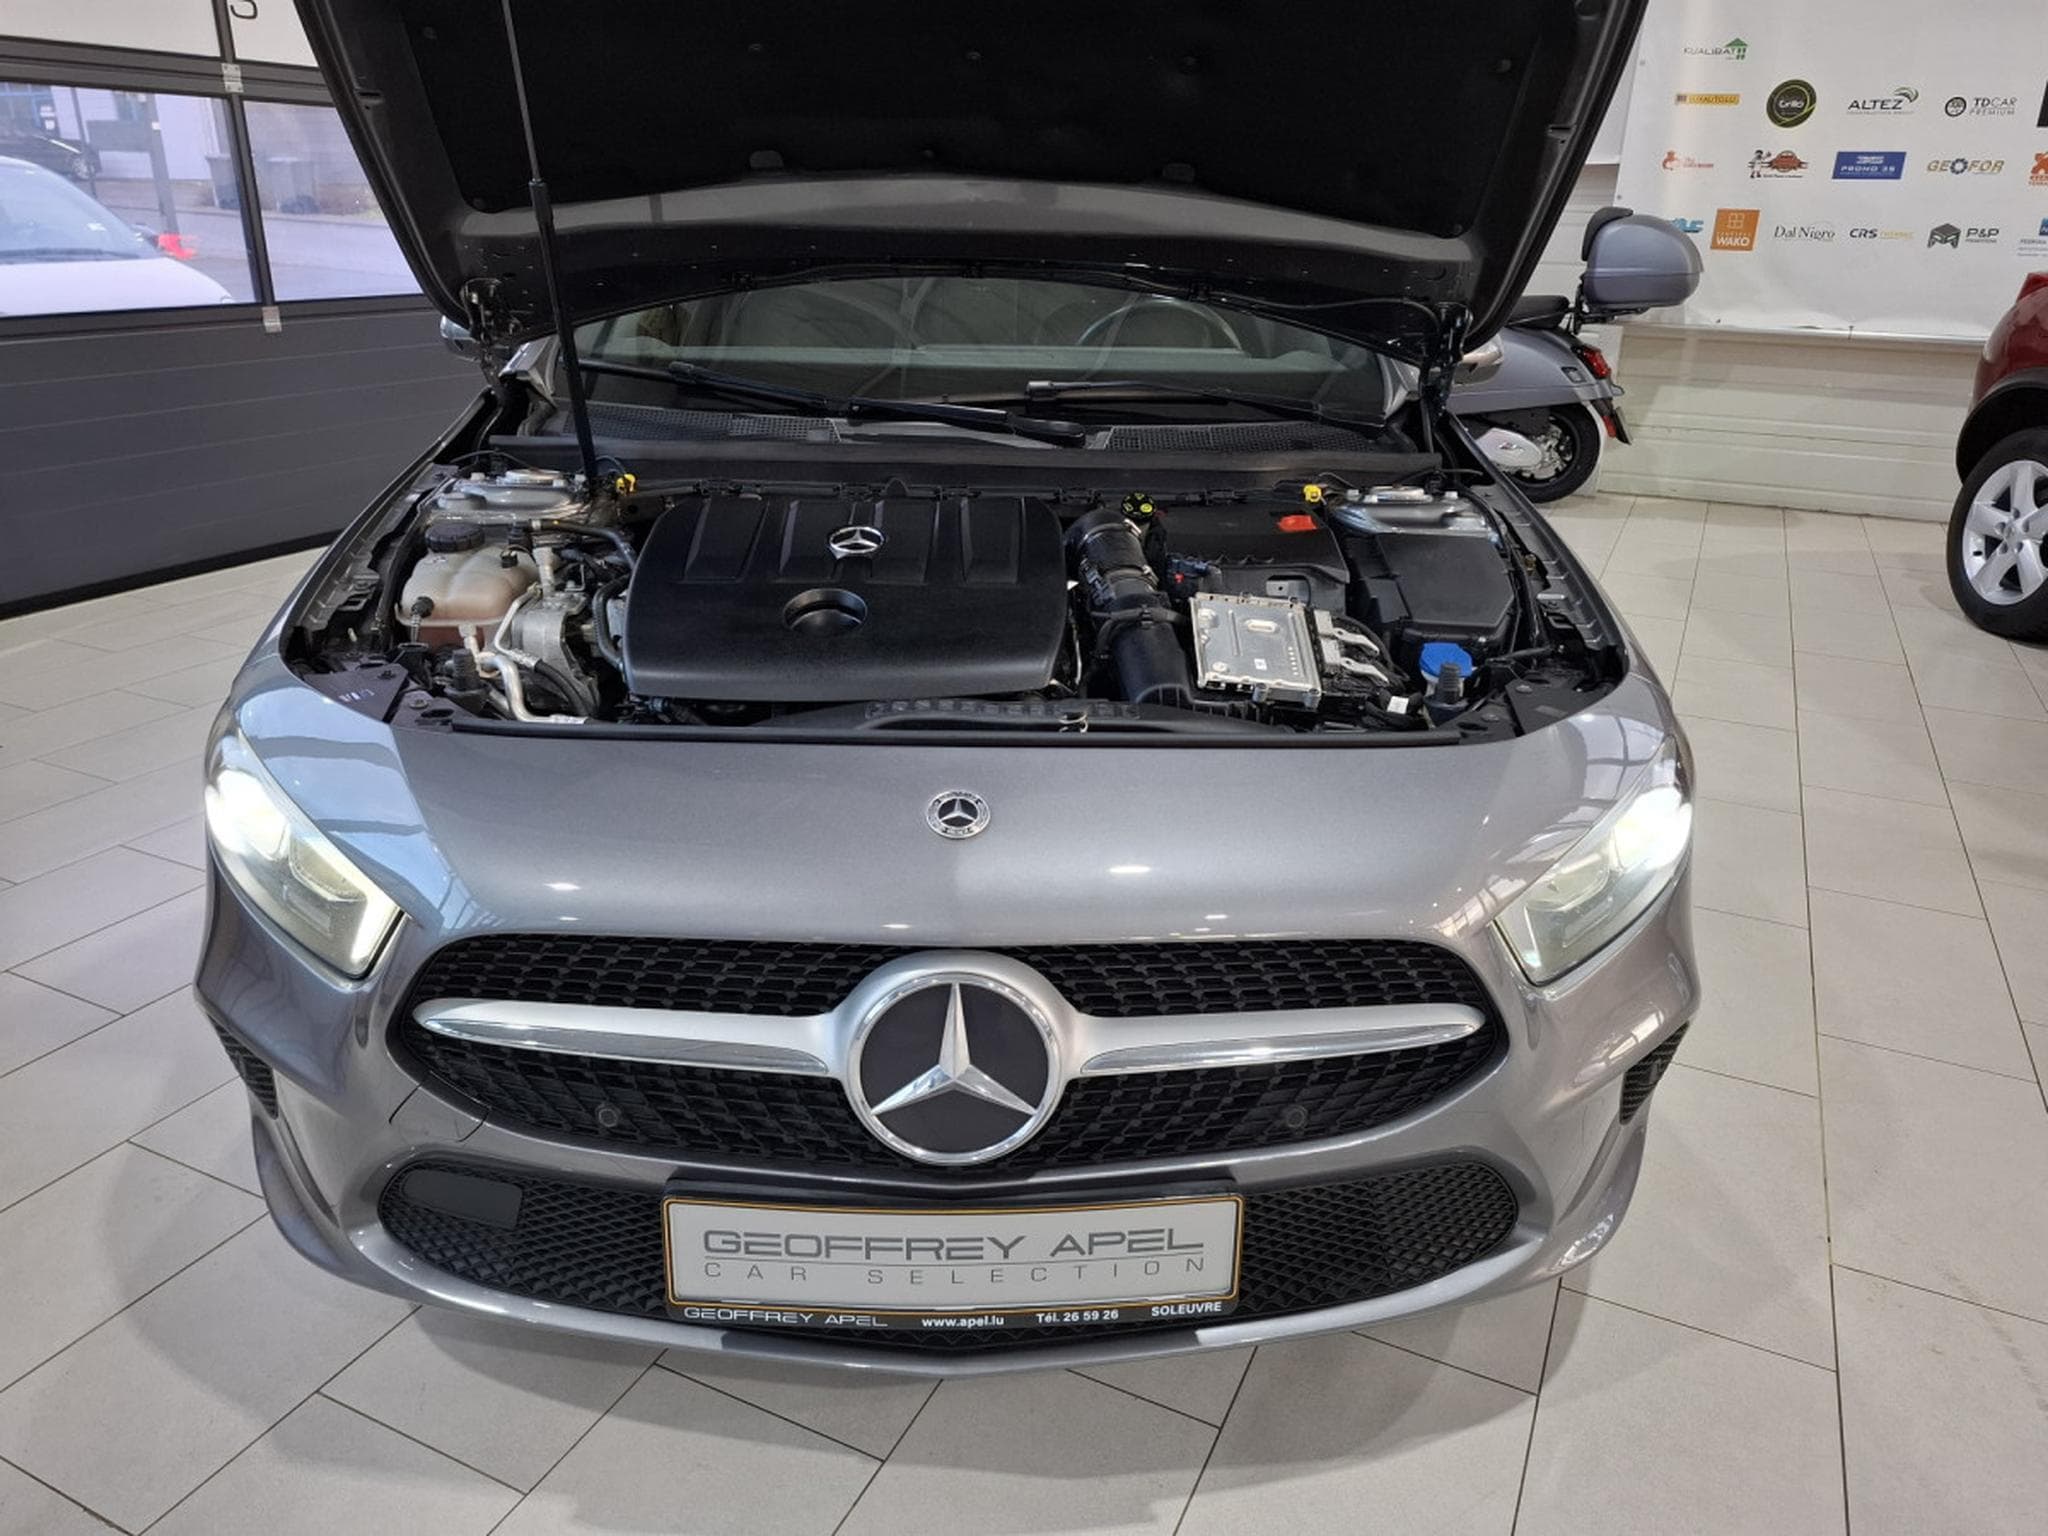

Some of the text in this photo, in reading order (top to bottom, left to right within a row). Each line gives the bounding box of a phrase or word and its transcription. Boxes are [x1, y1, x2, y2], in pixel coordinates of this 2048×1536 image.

[1848, 99, 1904, 110] ALTEZ
[1969, 107, 2016, 116] PREMIUM
[1840, 165, 1879, 173] PROMO
[1928, 158, 2004, 174] GEOFOR
[1774, 226, 1836, 241] Dal Nigro
[1849, 228, 1878, 239] CRS
[1965, 227, 2000, 238] P&P
[1717, 236, 1751, 247] WAKO
[703, 1228, 1204, 1261] GEOFFREY APEL
[704, 1257, 1205, 1285] CAR SELECTION
[1036, 1308, 1120, 1324] Tél. 26 59 26
[1151, 1301, 1223, 1317] SOLEUVRE
[683, 1306, 888, 1328] GEOFFREY APEL
[921, 1313, 1005, 1330] www.apel.lu
